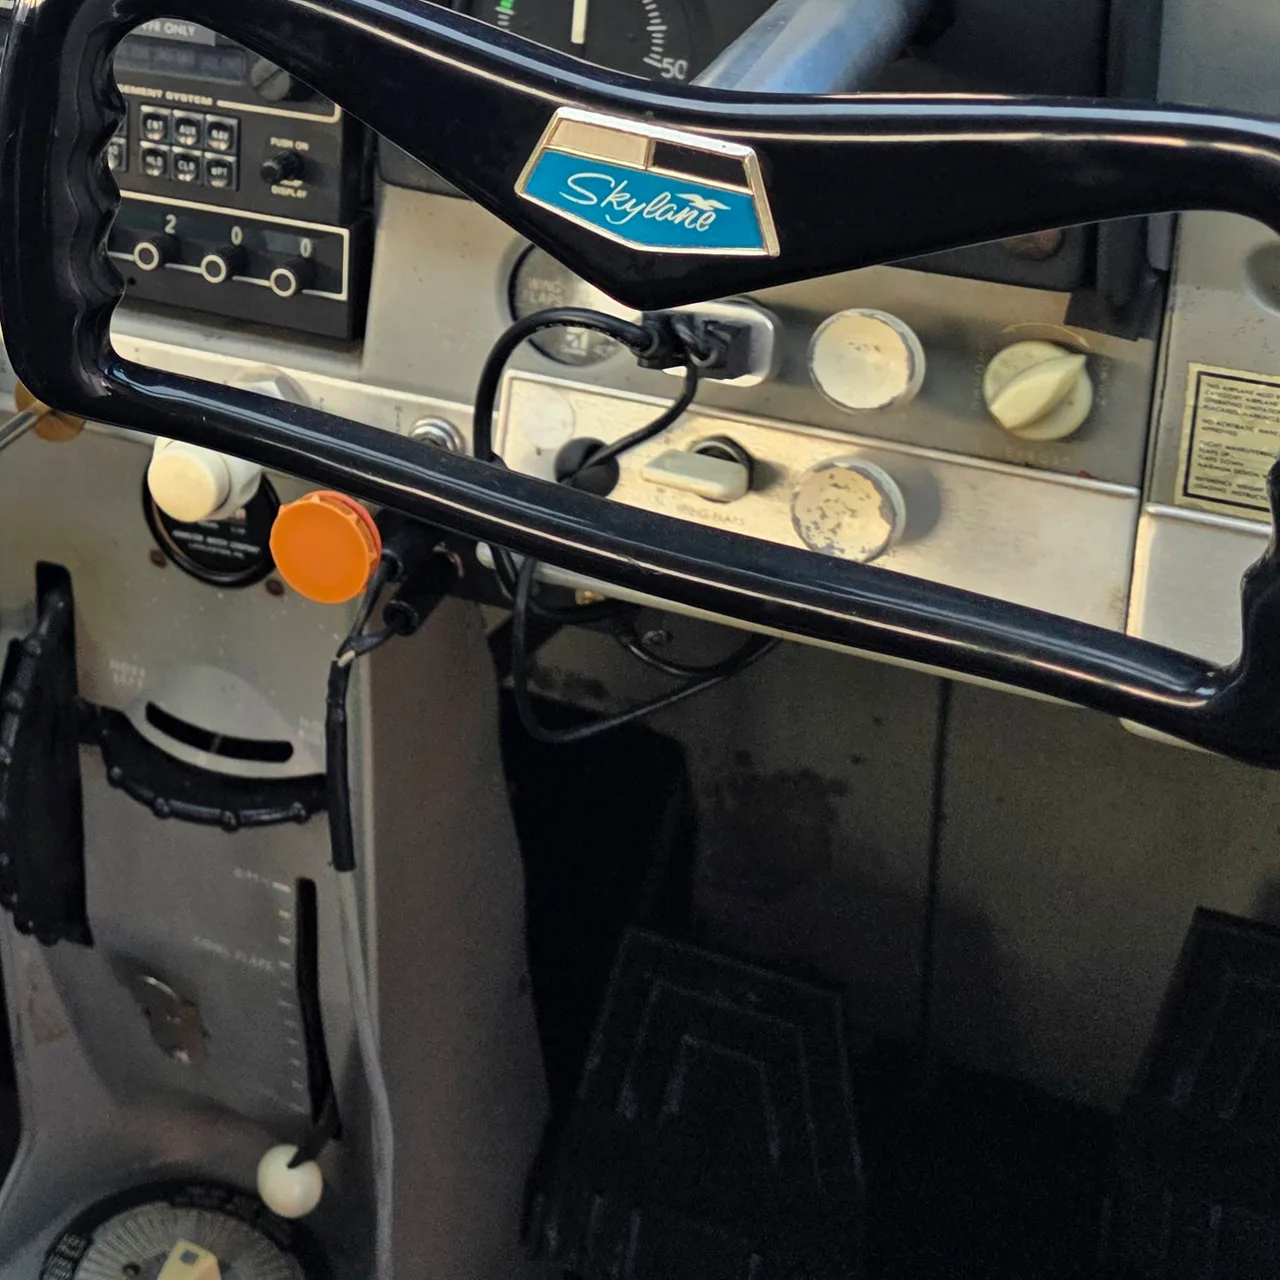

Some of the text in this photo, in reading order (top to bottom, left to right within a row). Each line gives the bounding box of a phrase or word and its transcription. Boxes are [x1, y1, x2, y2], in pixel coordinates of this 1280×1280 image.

[164, 22, 197, 37] ONLY
[659, 59, 688, 80] 50
[271, 185, 308, 199] DISPLAY
[560, 173, 716, 232] Skylane
[164, 214, 312, 258] 2 0 0
